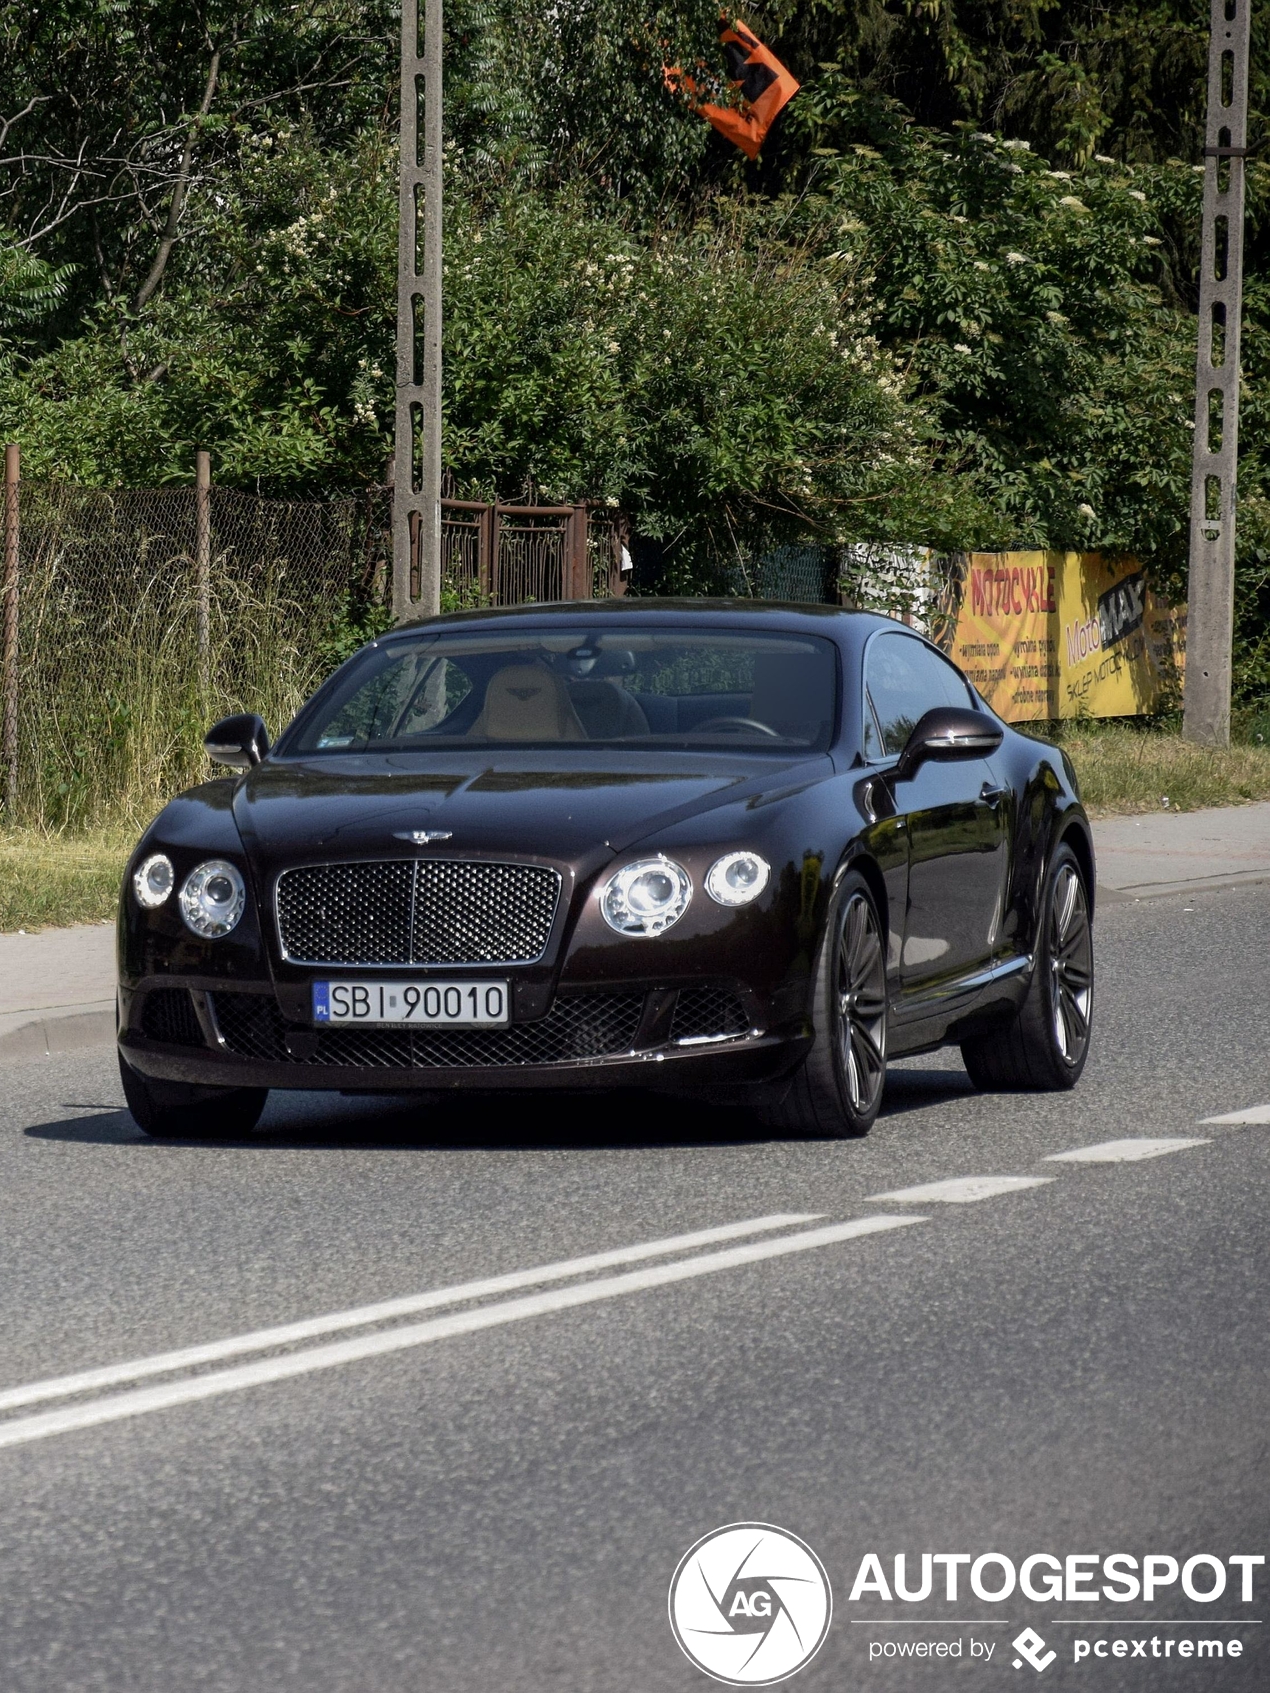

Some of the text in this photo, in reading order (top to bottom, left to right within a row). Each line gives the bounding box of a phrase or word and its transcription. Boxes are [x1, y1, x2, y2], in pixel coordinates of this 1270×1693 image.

[971, 565, 1056, 616] MOTOCYKLE
[1066, 671, 1092, 702] SKLEP
[316, 1006, 328, 1015] PL
[332, 985, 503, 1018] SBI 90010
